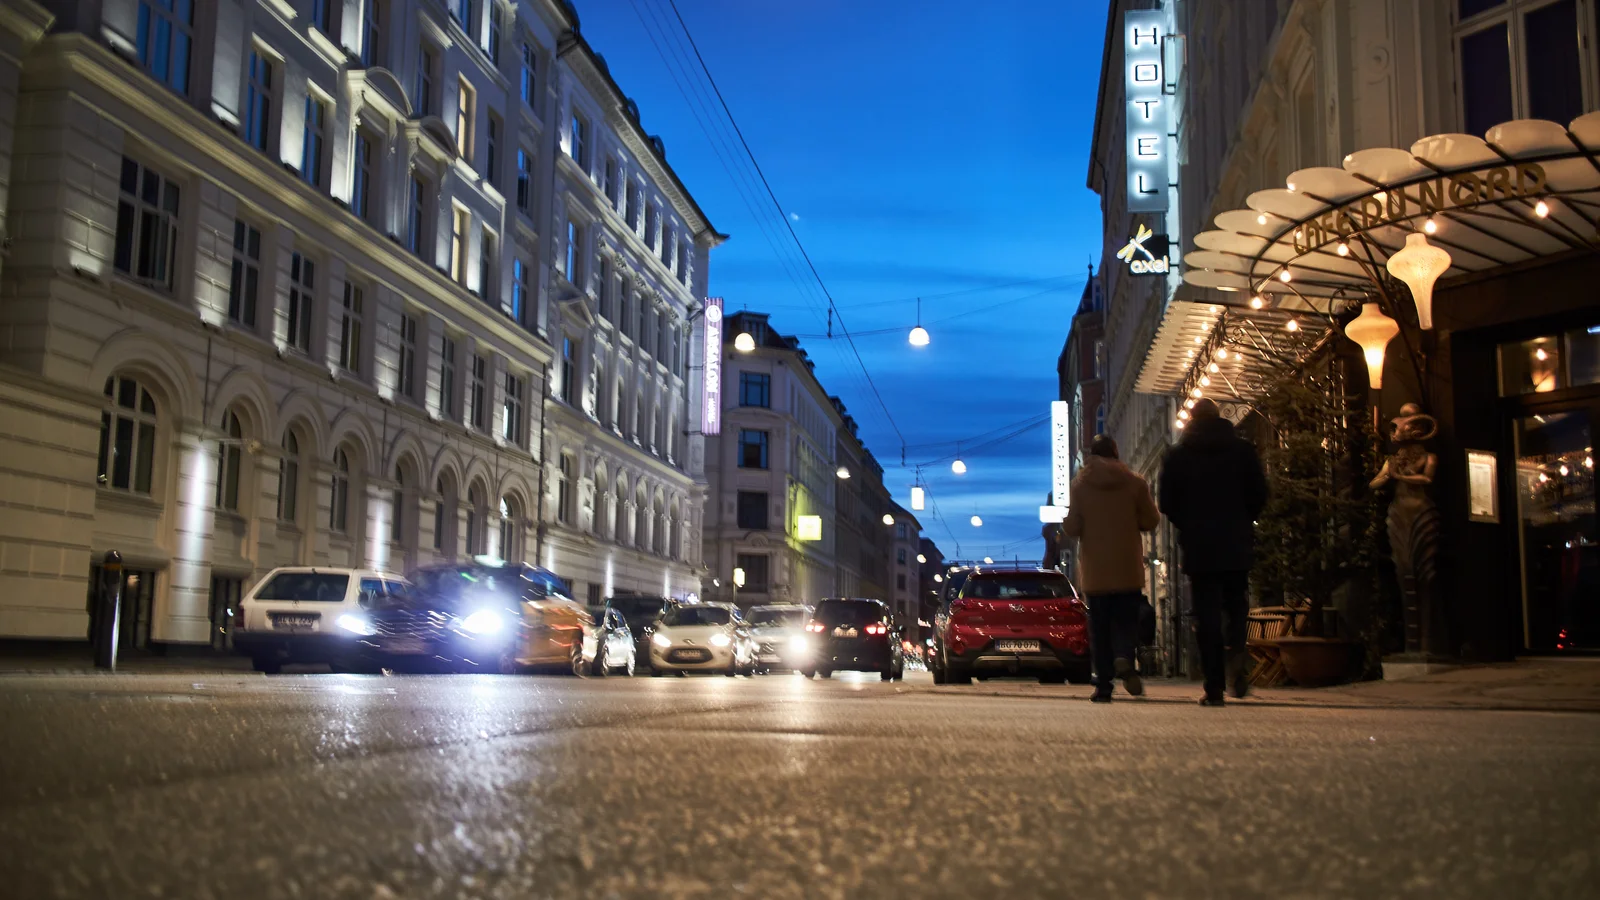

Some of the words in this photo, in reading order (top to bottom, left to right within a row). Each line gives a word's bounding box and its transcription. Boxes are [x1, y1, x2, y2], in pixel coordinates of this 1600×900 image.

[1134, 27, 1159, 194] HOTEL
[1360, 187, 1407, 229] DU
[1419, 162, 1547, 214] NORD
[1130, 255, 1169, 274] axel
